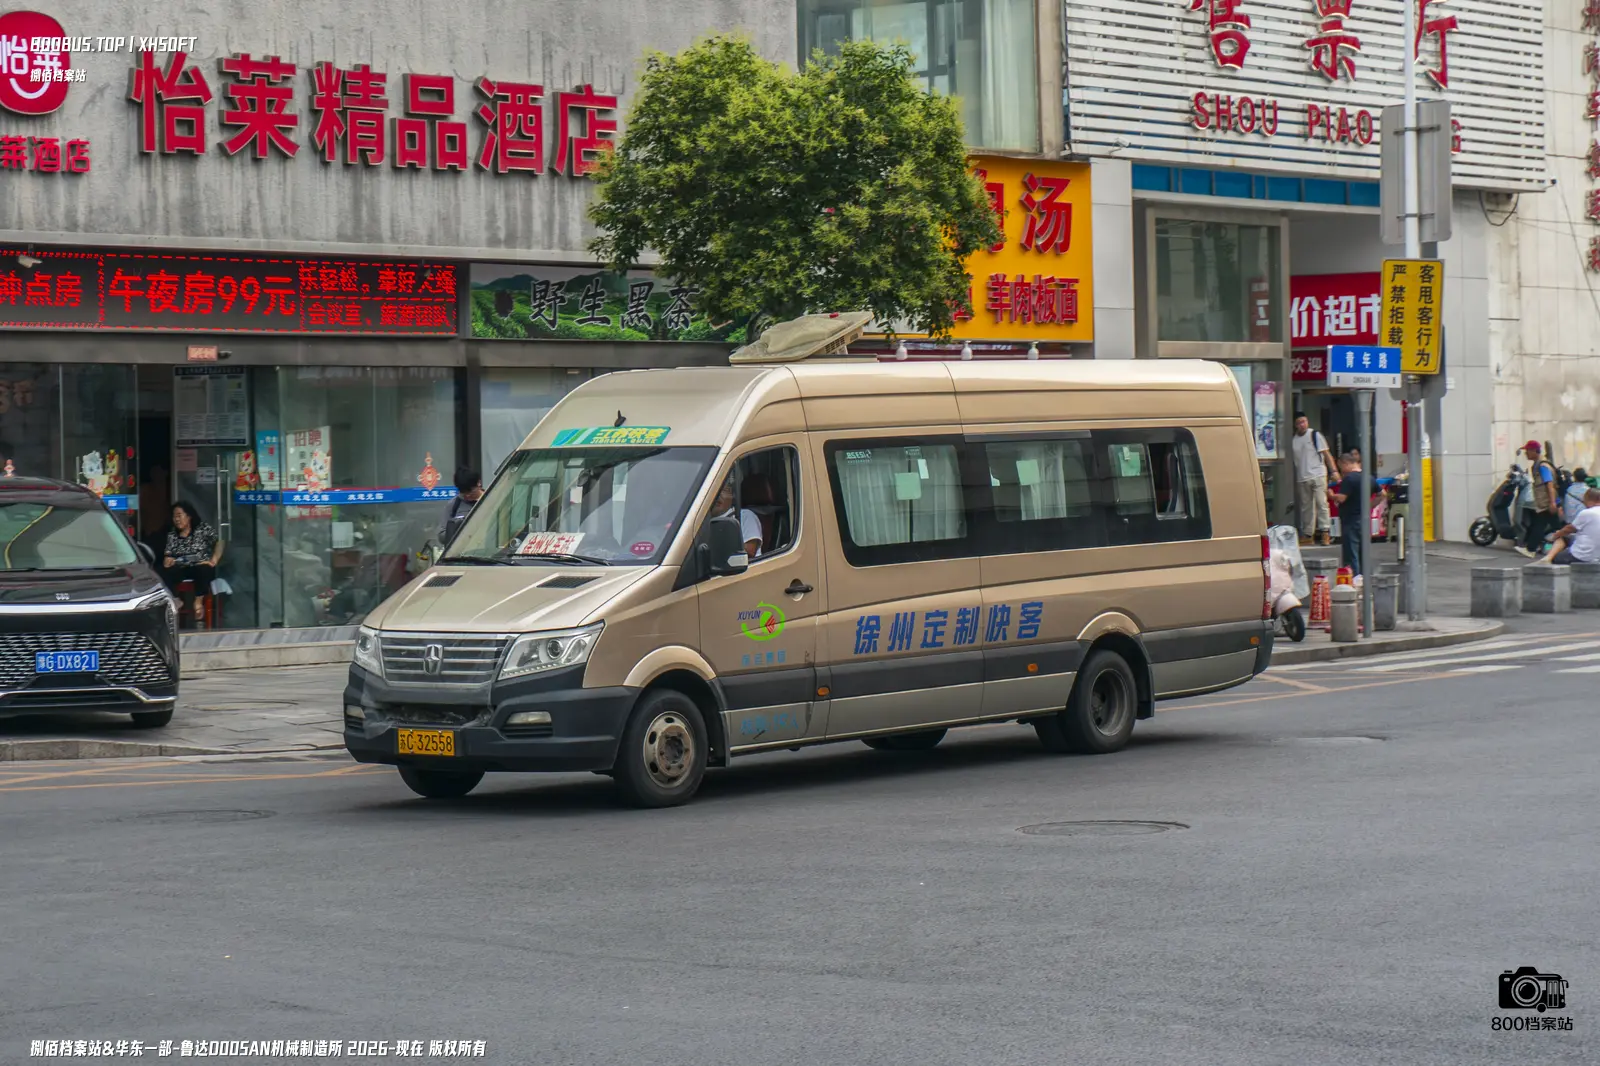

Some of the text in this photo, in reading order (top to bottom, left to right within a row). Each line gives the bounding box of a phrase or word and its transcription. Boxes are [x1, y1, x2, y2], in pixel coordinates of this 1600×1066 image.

[129, 50, 619, 177] 怡莱精品酒店
[1192, 91, 1373, 145] SHOU PIAO
[0, 134, 92, 173] 莱酒店
[108, 267, 297, 317] 午夜房99元
[530, 277, 700, 331] 野生黑茶
[986, 273, 1080, 325] 羊肉板面
[1289, 293, 1382, 338] 价超市
[1388, 264, 1407, 346] 严禁拒载
[1416, 264, 1435, 367] 客甩客行为
[1290, 356, 1328, 374] 欢迎
[1345, 350, 1388, 369] 青年路
[294, 429, 322, 447] 招聘
[737, 610, 761, 621] XUYUN
[854, 601, 1044, 655] 徐州定制快客
